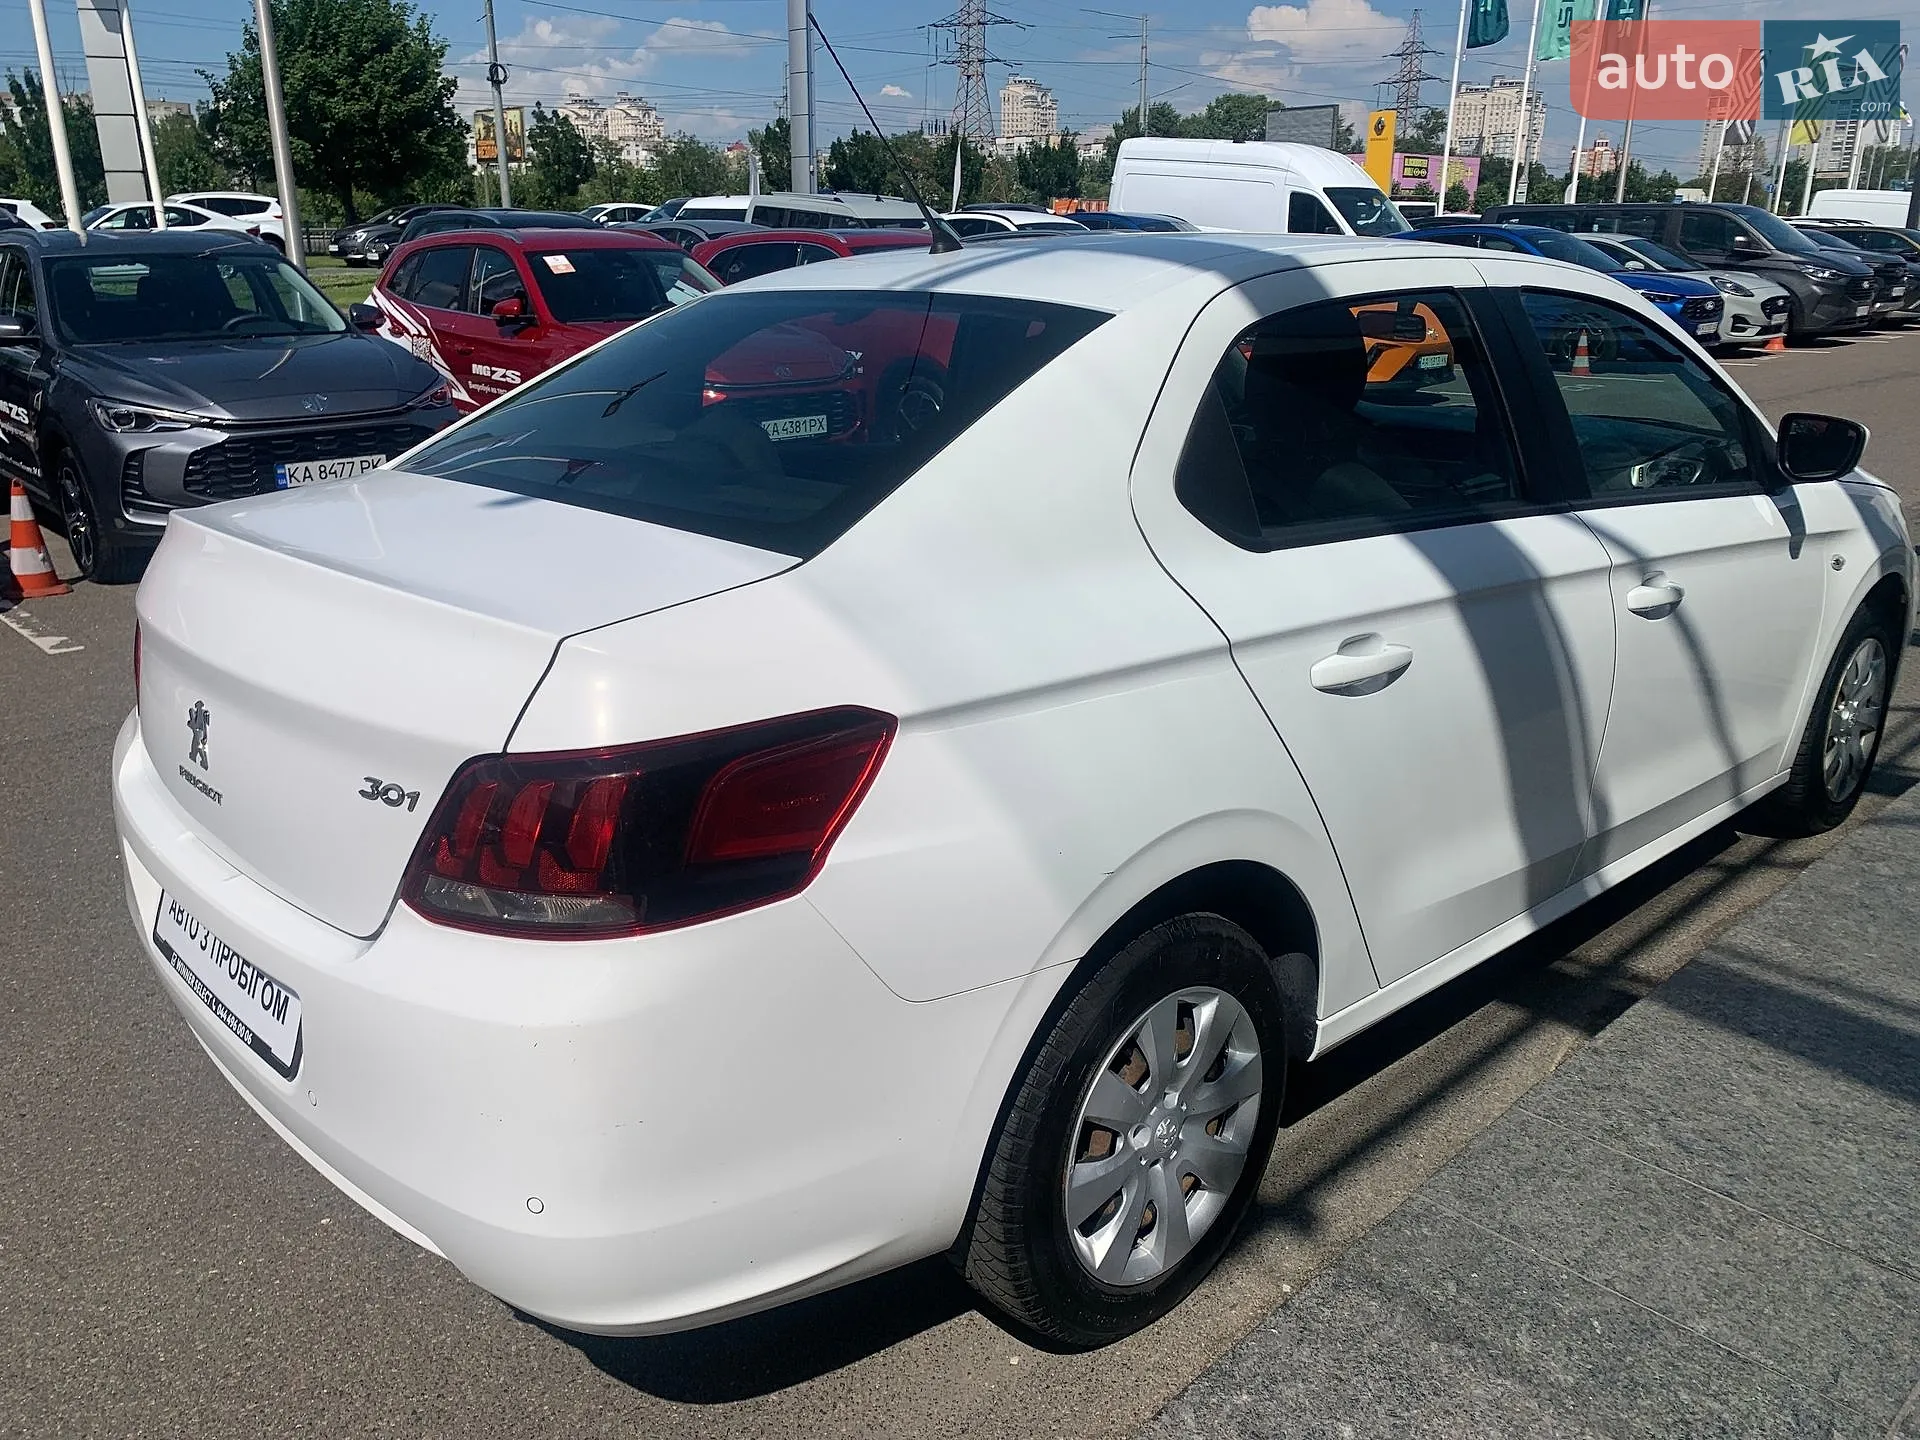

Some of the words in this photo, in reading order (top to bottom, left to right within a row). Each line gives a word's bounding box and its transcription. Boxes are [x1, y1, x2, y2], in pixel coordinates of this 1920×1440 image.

[491, 367, 521, 384] ZS
[8, 403, 29, 424] ZS
[288, 466, 314, 483] KA
[318, 461, 355, 480] 8477
[179, 764, 223, 806] PEUGEOT
[358, 776, 421, 812] 301
[193, 980, 212, 1005] SELECT
[210, 936, 290, 1025] ПРОБІГОМ
